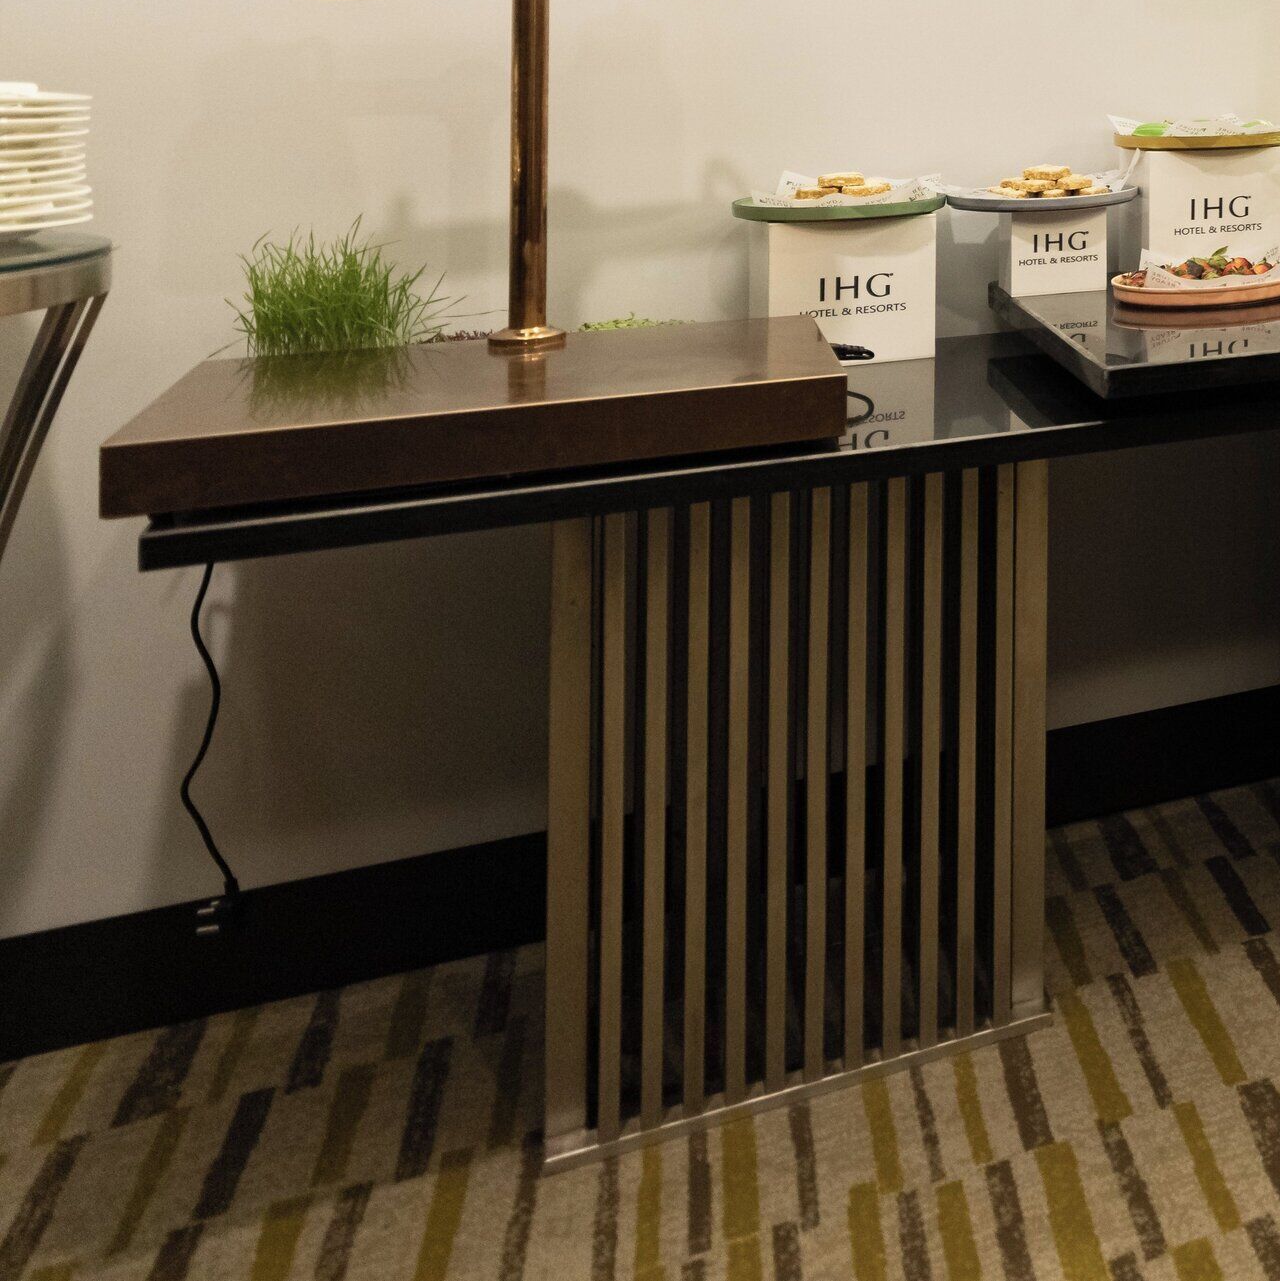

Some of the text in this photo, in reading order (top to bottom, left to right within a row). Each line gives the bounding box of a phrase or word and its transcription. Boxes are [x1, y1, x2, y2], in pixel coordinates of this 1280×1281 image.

[1190, 195, 1252, 220] IHG
[1173, 222, 1263, 236] HOTEL & RESORTS
[1033, 231, 1089, 253] IHG
[1018, 258, 1048, 266] HOTEL
[1060, 254, 1099, 263] RESORTS
[819, 273, 894, 302] IHG
[841, 307, 852, 316] &
[855, 302, 907, 315] RESORTS
